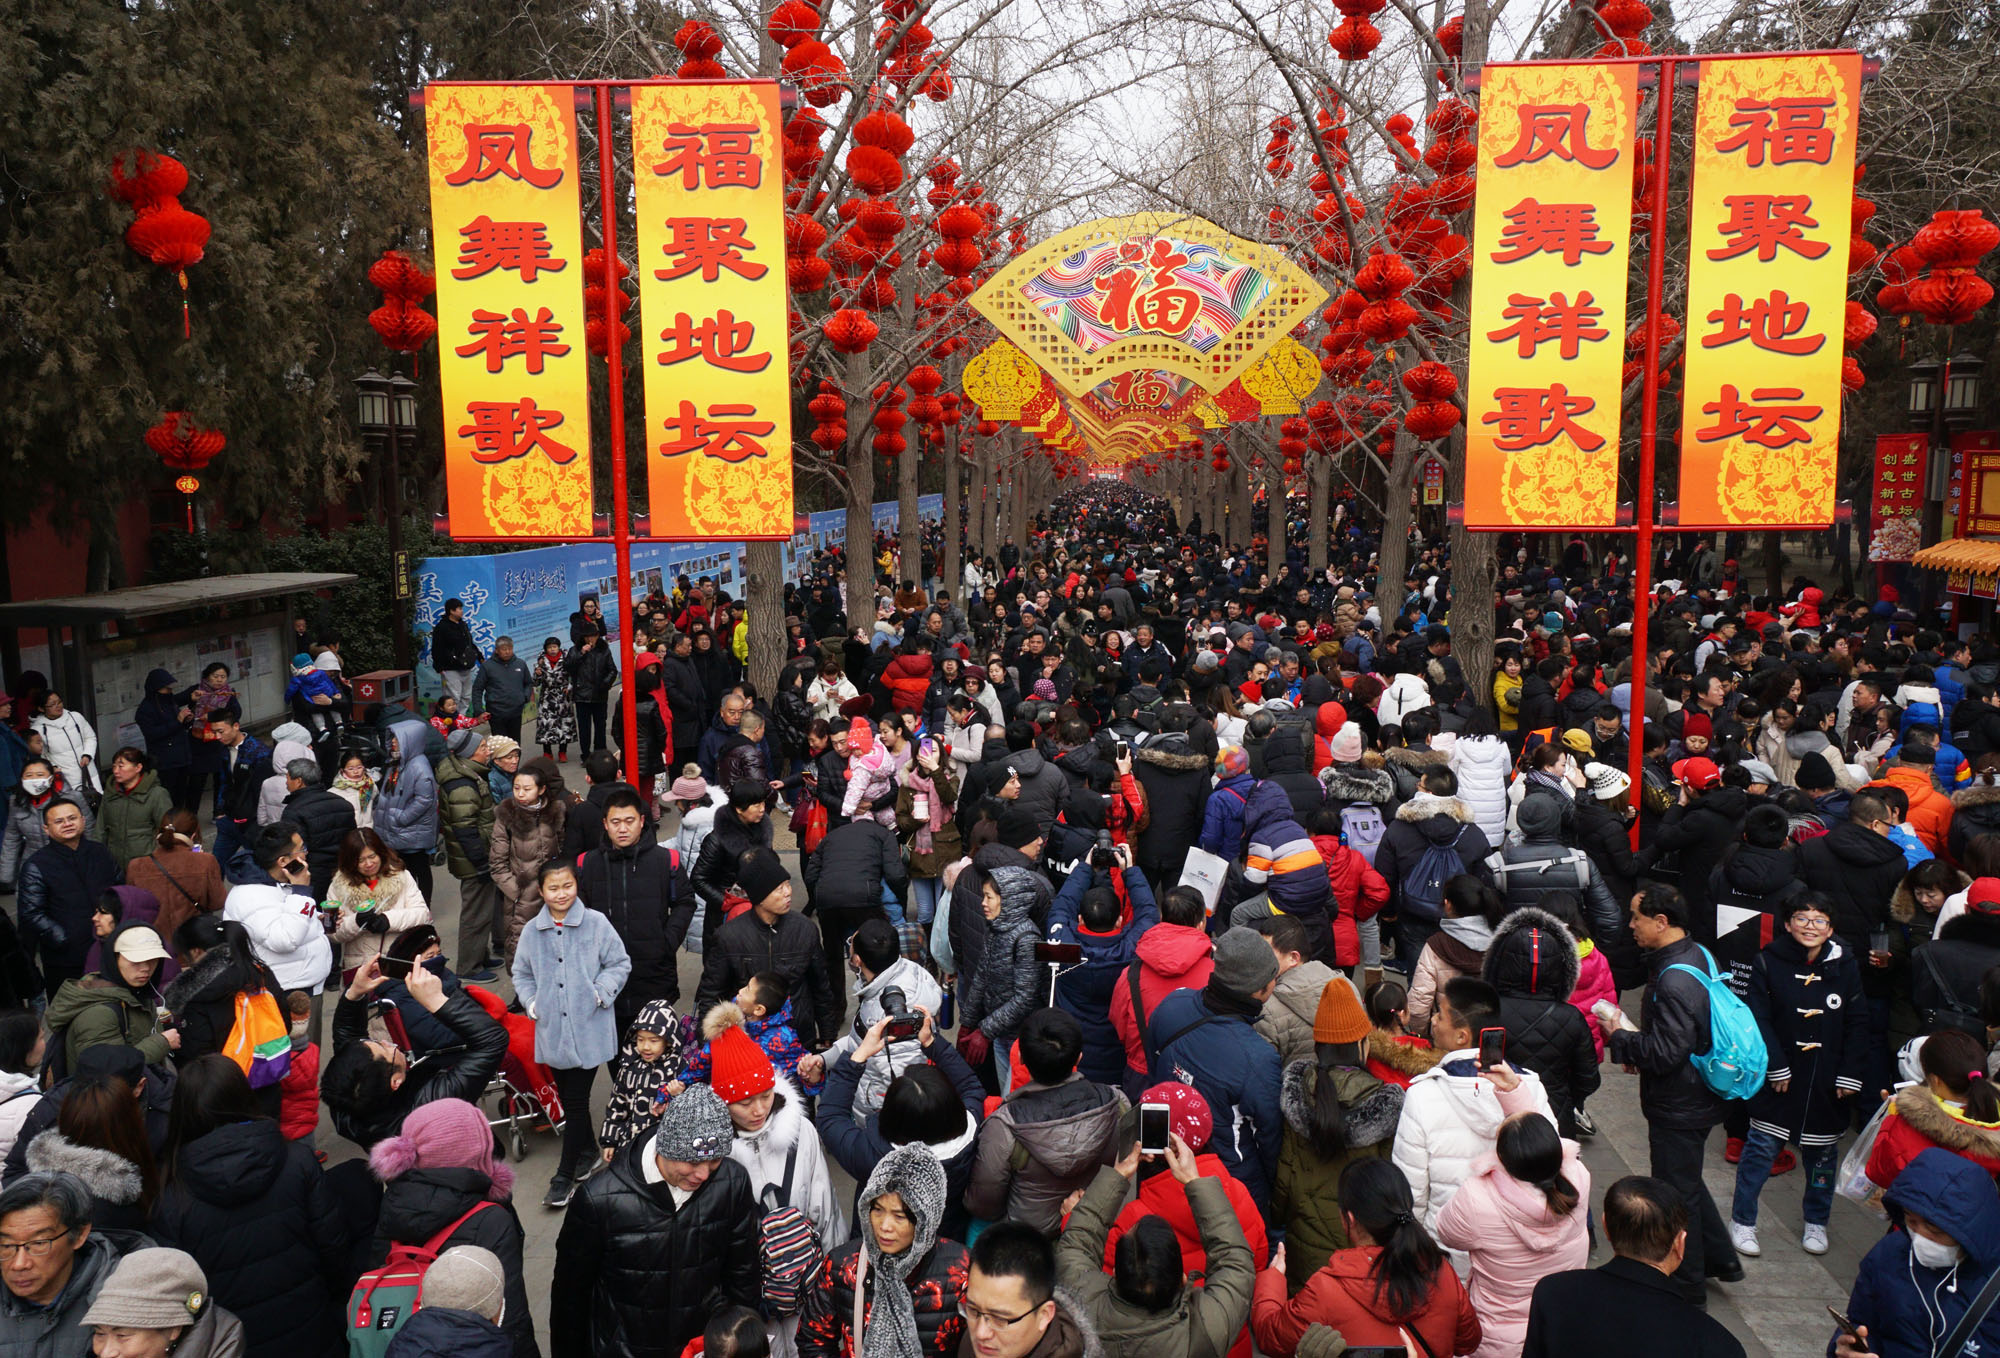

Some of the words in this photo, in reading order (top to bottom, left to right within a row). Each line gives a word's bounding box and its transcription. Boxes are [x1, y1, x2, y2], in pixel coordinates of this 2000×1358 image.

[445, 123, 577, 465] 凤舞祥歌
[651, 123, 775, 463] 福聚地坛
[1094, 238, 1203, 335] 福
[1481, 102, 1619, 452] 凤舞祥歌
[1696, 97, 1836, 449] 福聚地坛
[1110, 368, 1169, 407] 福
[180, 478, 195, 490] 福
[1878, 453, 1898, 516] 创意新春
[1898, 452, 1918, 515] 盛世古坛
[398, 554, 408, 595] 禁止吸烟
